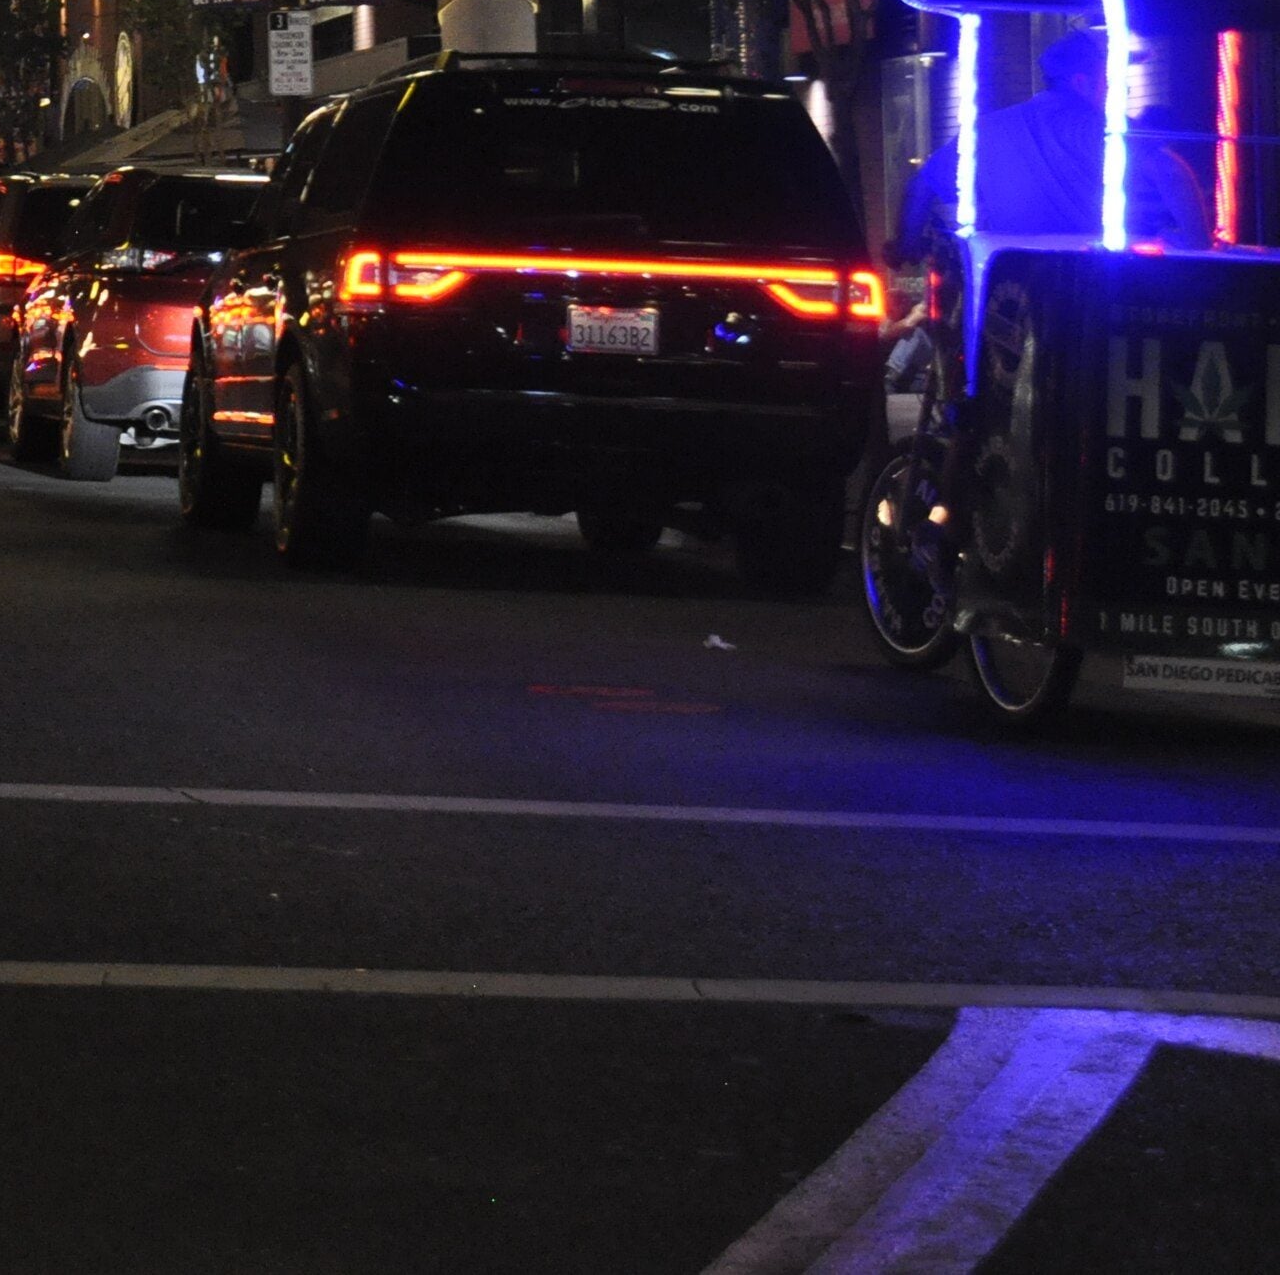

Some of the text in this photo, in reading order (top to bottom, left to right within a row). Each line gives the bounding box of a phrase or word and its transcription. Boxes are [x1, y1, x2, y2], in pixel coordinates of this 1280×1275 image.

[275, 14, 284, 29] 3
[574, 324, 651, 347] 31163B2
[1106, 446, 1270, 487] COLL
[1103, 493, 1250, 520] 619-841-2045
[1143, 525, 1268, 572] SAN
[1165, 575, 1280, 601] OPEN EVE
[1119, 612, 1175, 636] MILE
[1187, 615, 1259, 639] SOUTH
[1125, 661, 1159, 680] SAN
[1162, 663, 1214, 682] DIEGO
